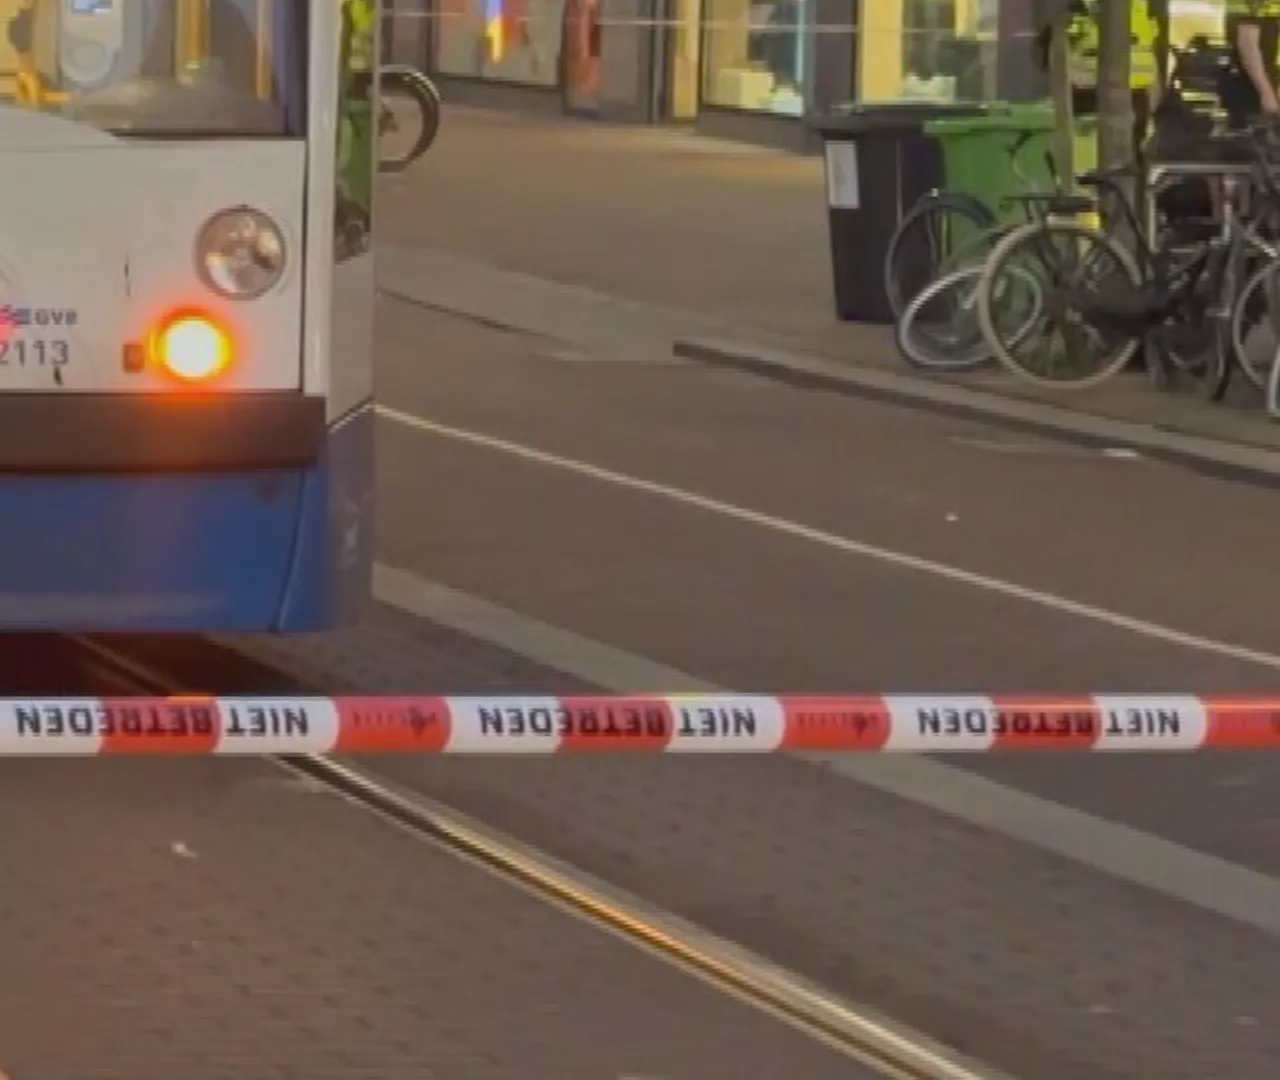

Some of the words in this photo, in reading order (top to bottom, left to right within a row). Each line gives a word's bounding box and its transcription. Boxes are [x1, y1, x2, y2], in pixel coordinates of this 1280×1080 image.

[15, 705, 212, 736] BETREDEN
[225, 705, 309, 736] NIET
[478, 705, 666, 735] BETREDEN
[677, 704, 757, 735] NIET
[917, 707, 1100, 736] BETREDEN
[1106, 707, 1181, 736] NIET
